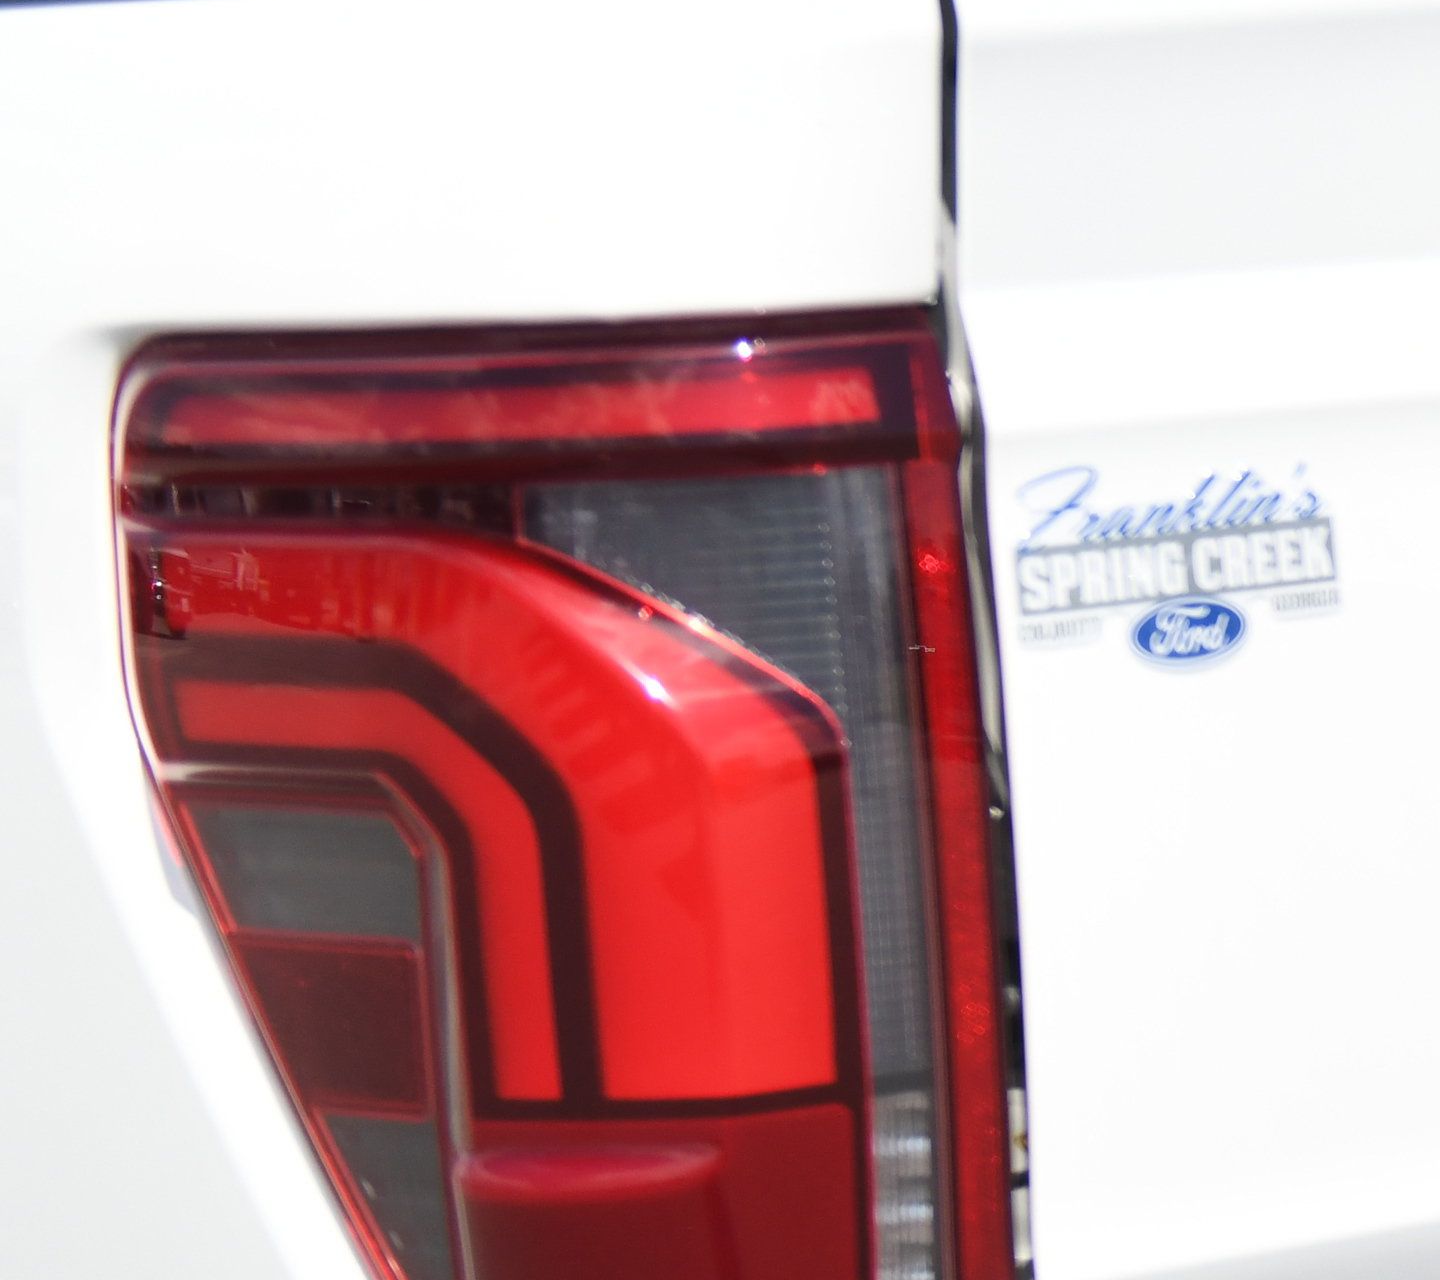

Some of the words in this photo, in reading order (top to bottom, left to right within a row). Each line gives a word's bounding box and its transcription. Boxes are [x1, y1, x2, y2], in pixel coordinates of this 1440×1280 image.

[1016, 461, 1322, 554] Franklin's
[1020, 540, 1189, 612] SPRING
[1192, 524, 1335, 594] CREEK
[1149, 604, 1230, 658] Ford
